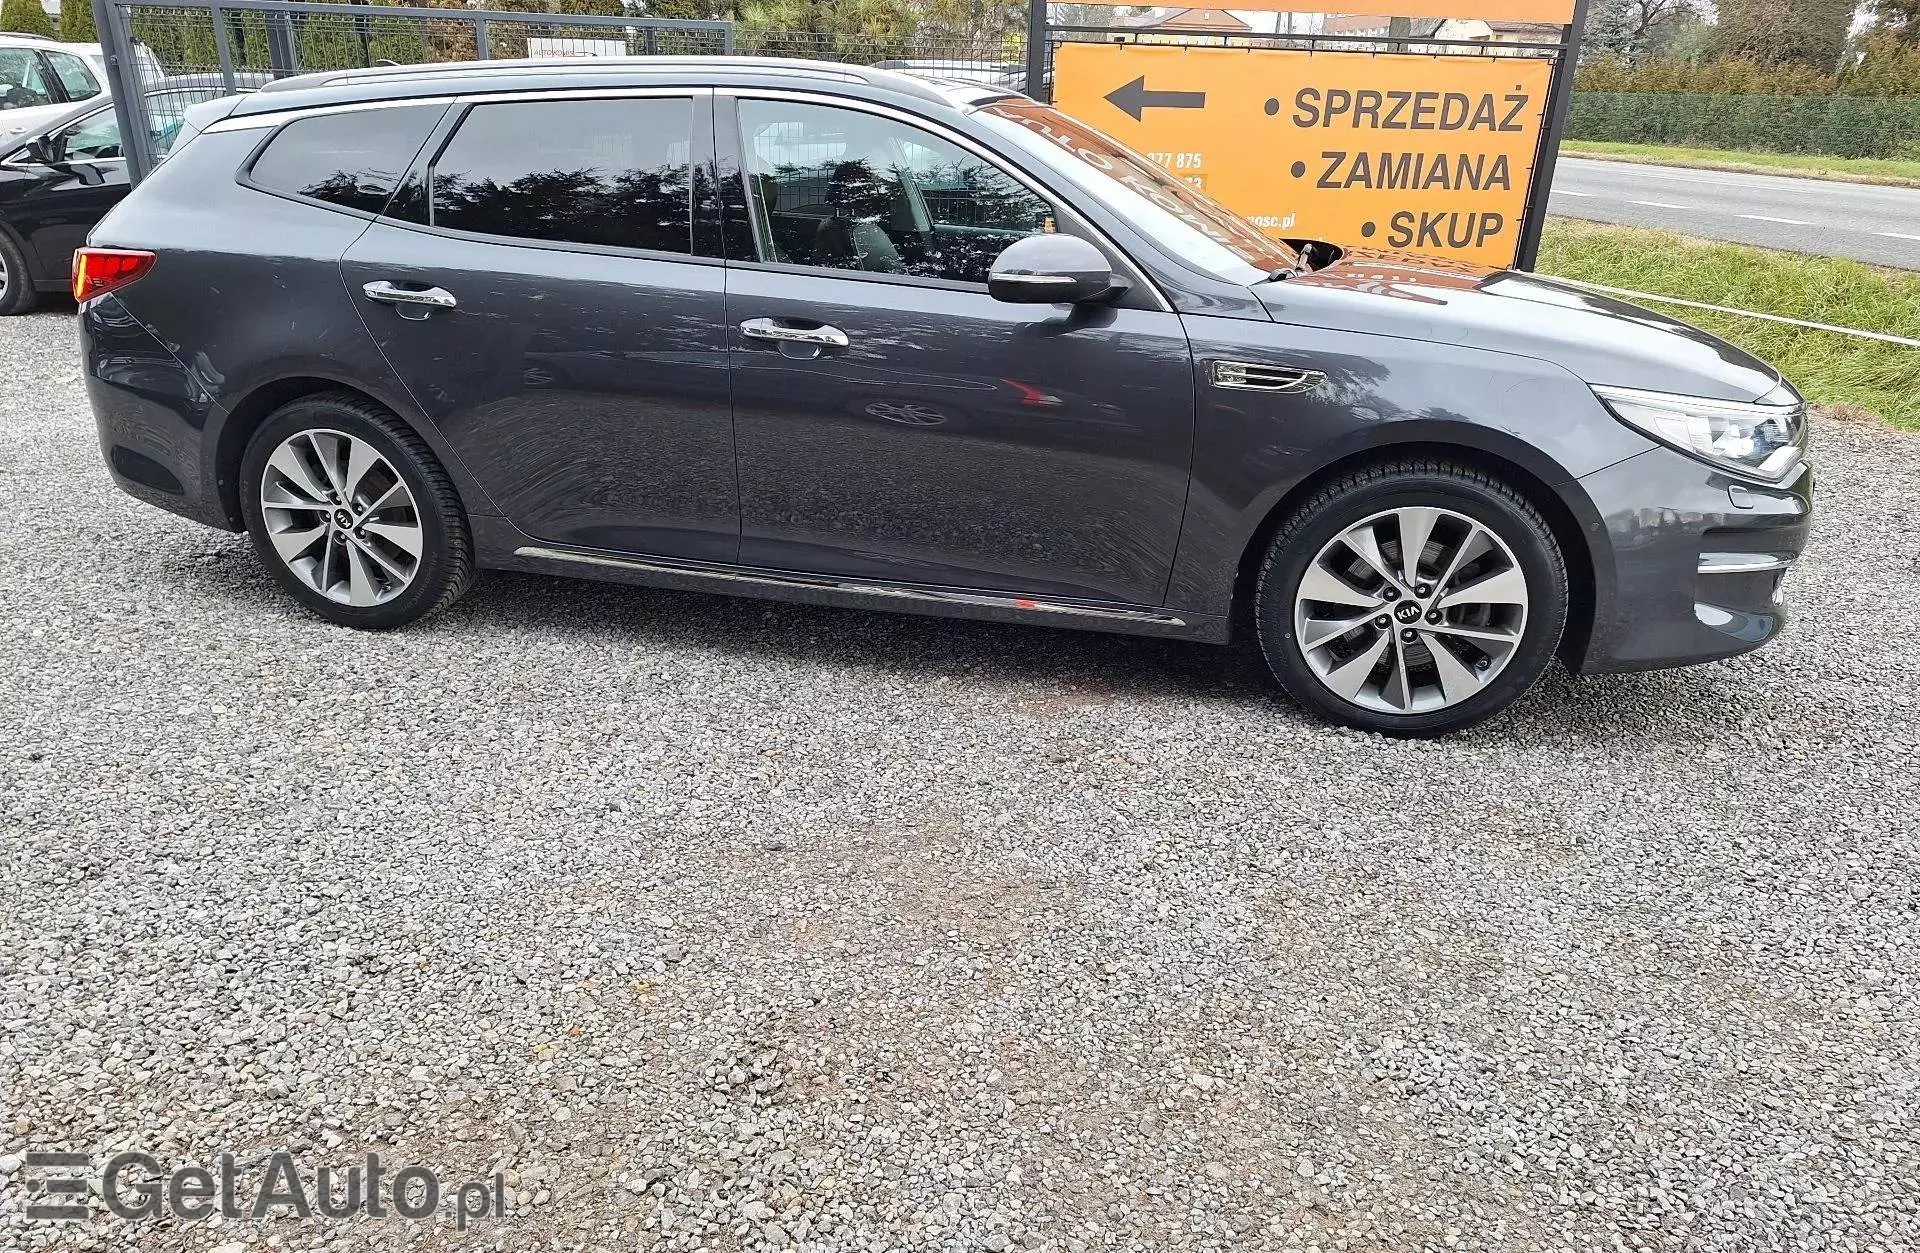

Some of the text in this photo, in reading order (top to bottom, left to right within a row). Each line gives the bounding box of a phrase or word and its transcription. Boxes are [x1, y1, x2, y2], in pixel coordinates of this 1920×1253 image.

[1292, 84, 1529, 132] SPRZEDAŻ
[1176, 151, 1202, 169] 875
[1316, 151, 1511, 190] ZAMIANA
[1387, 210, 1504, 248] SKUP
[337, 511, 351, 528] KIA
[1397, 606, 1420, 620] KIA
